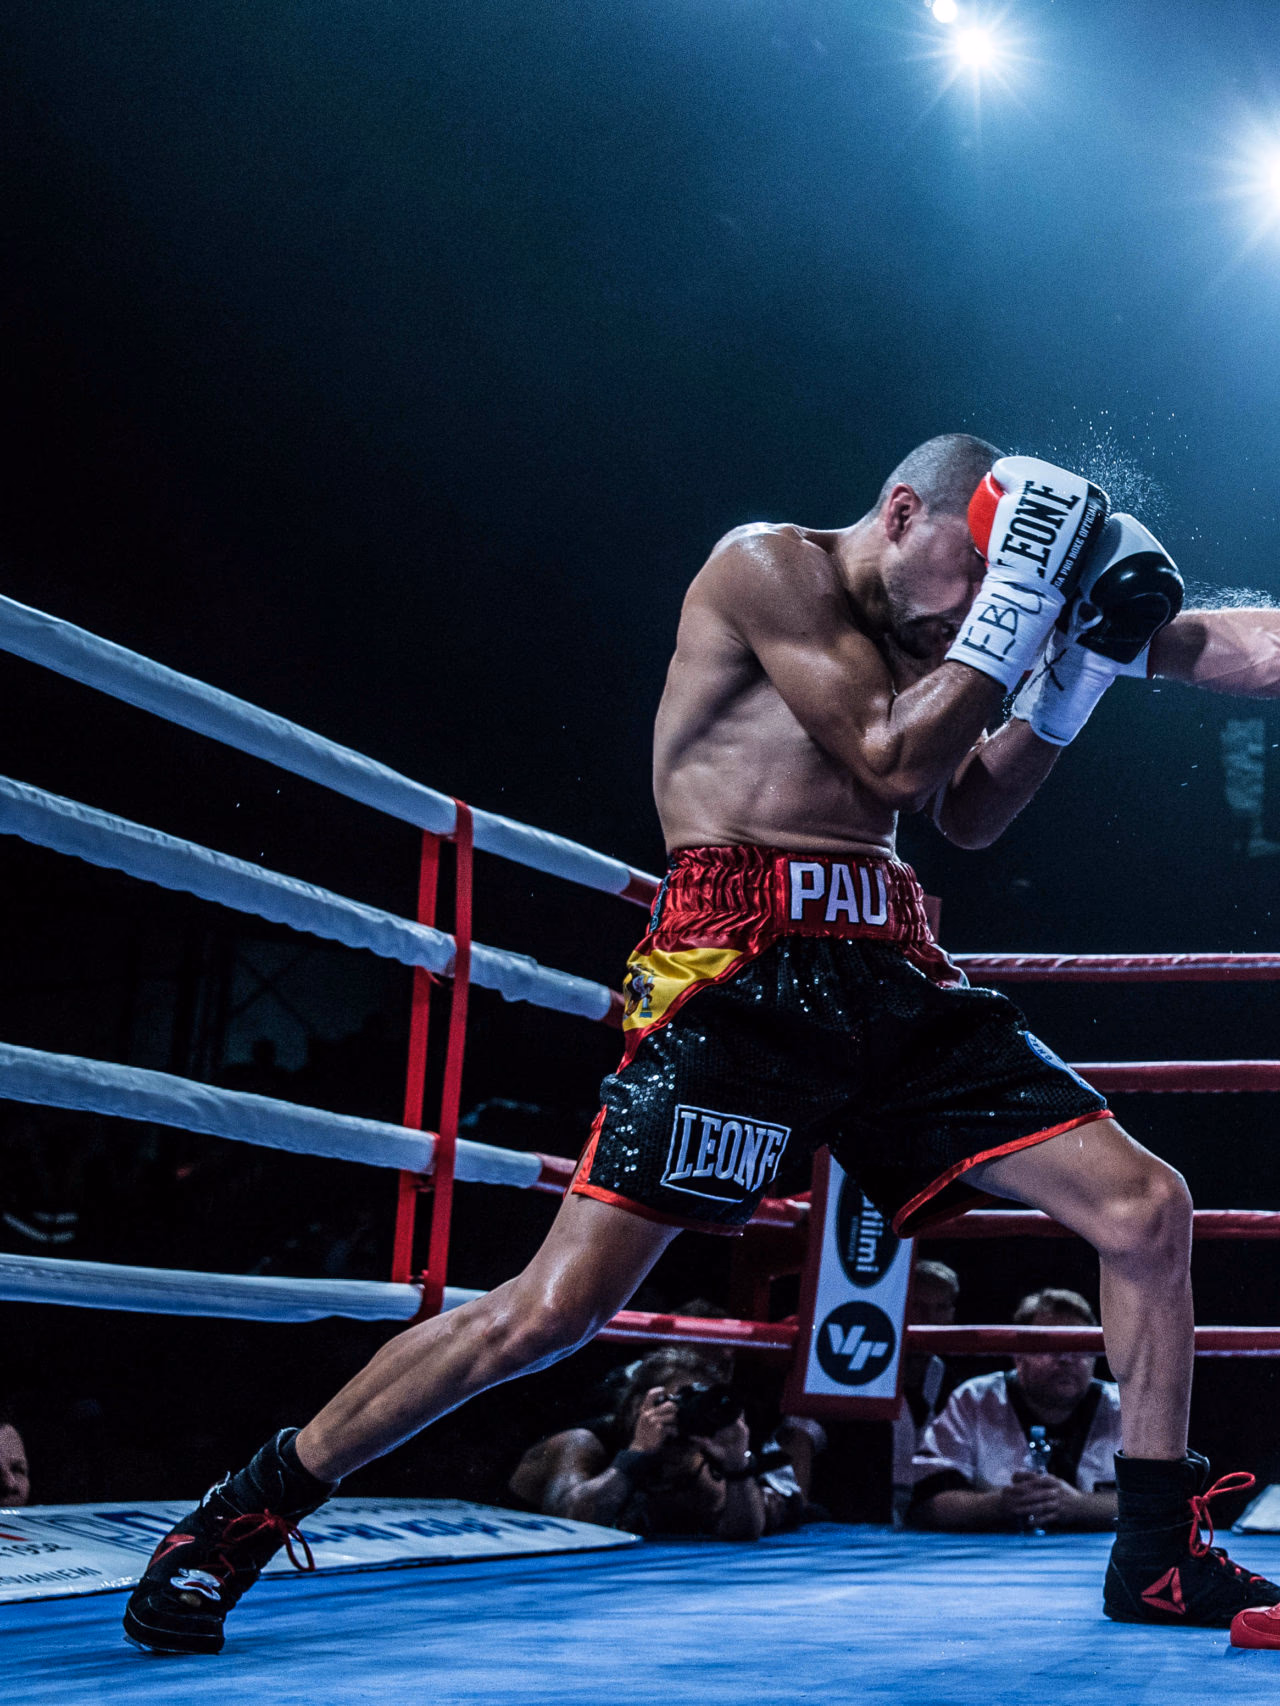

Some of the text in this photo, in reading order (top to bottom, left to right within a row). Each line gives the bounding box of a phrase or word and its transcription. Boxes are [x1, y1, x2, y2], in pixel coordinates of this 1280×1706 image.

[1061, 560, 1075, 576] PRO
[1069, 537, 1085, 559] BOXE
[961, 581, 1045, 661] EBU
[788, 861, 888, 927] PAU
[668, 1111, 784, 1192] LEONE
